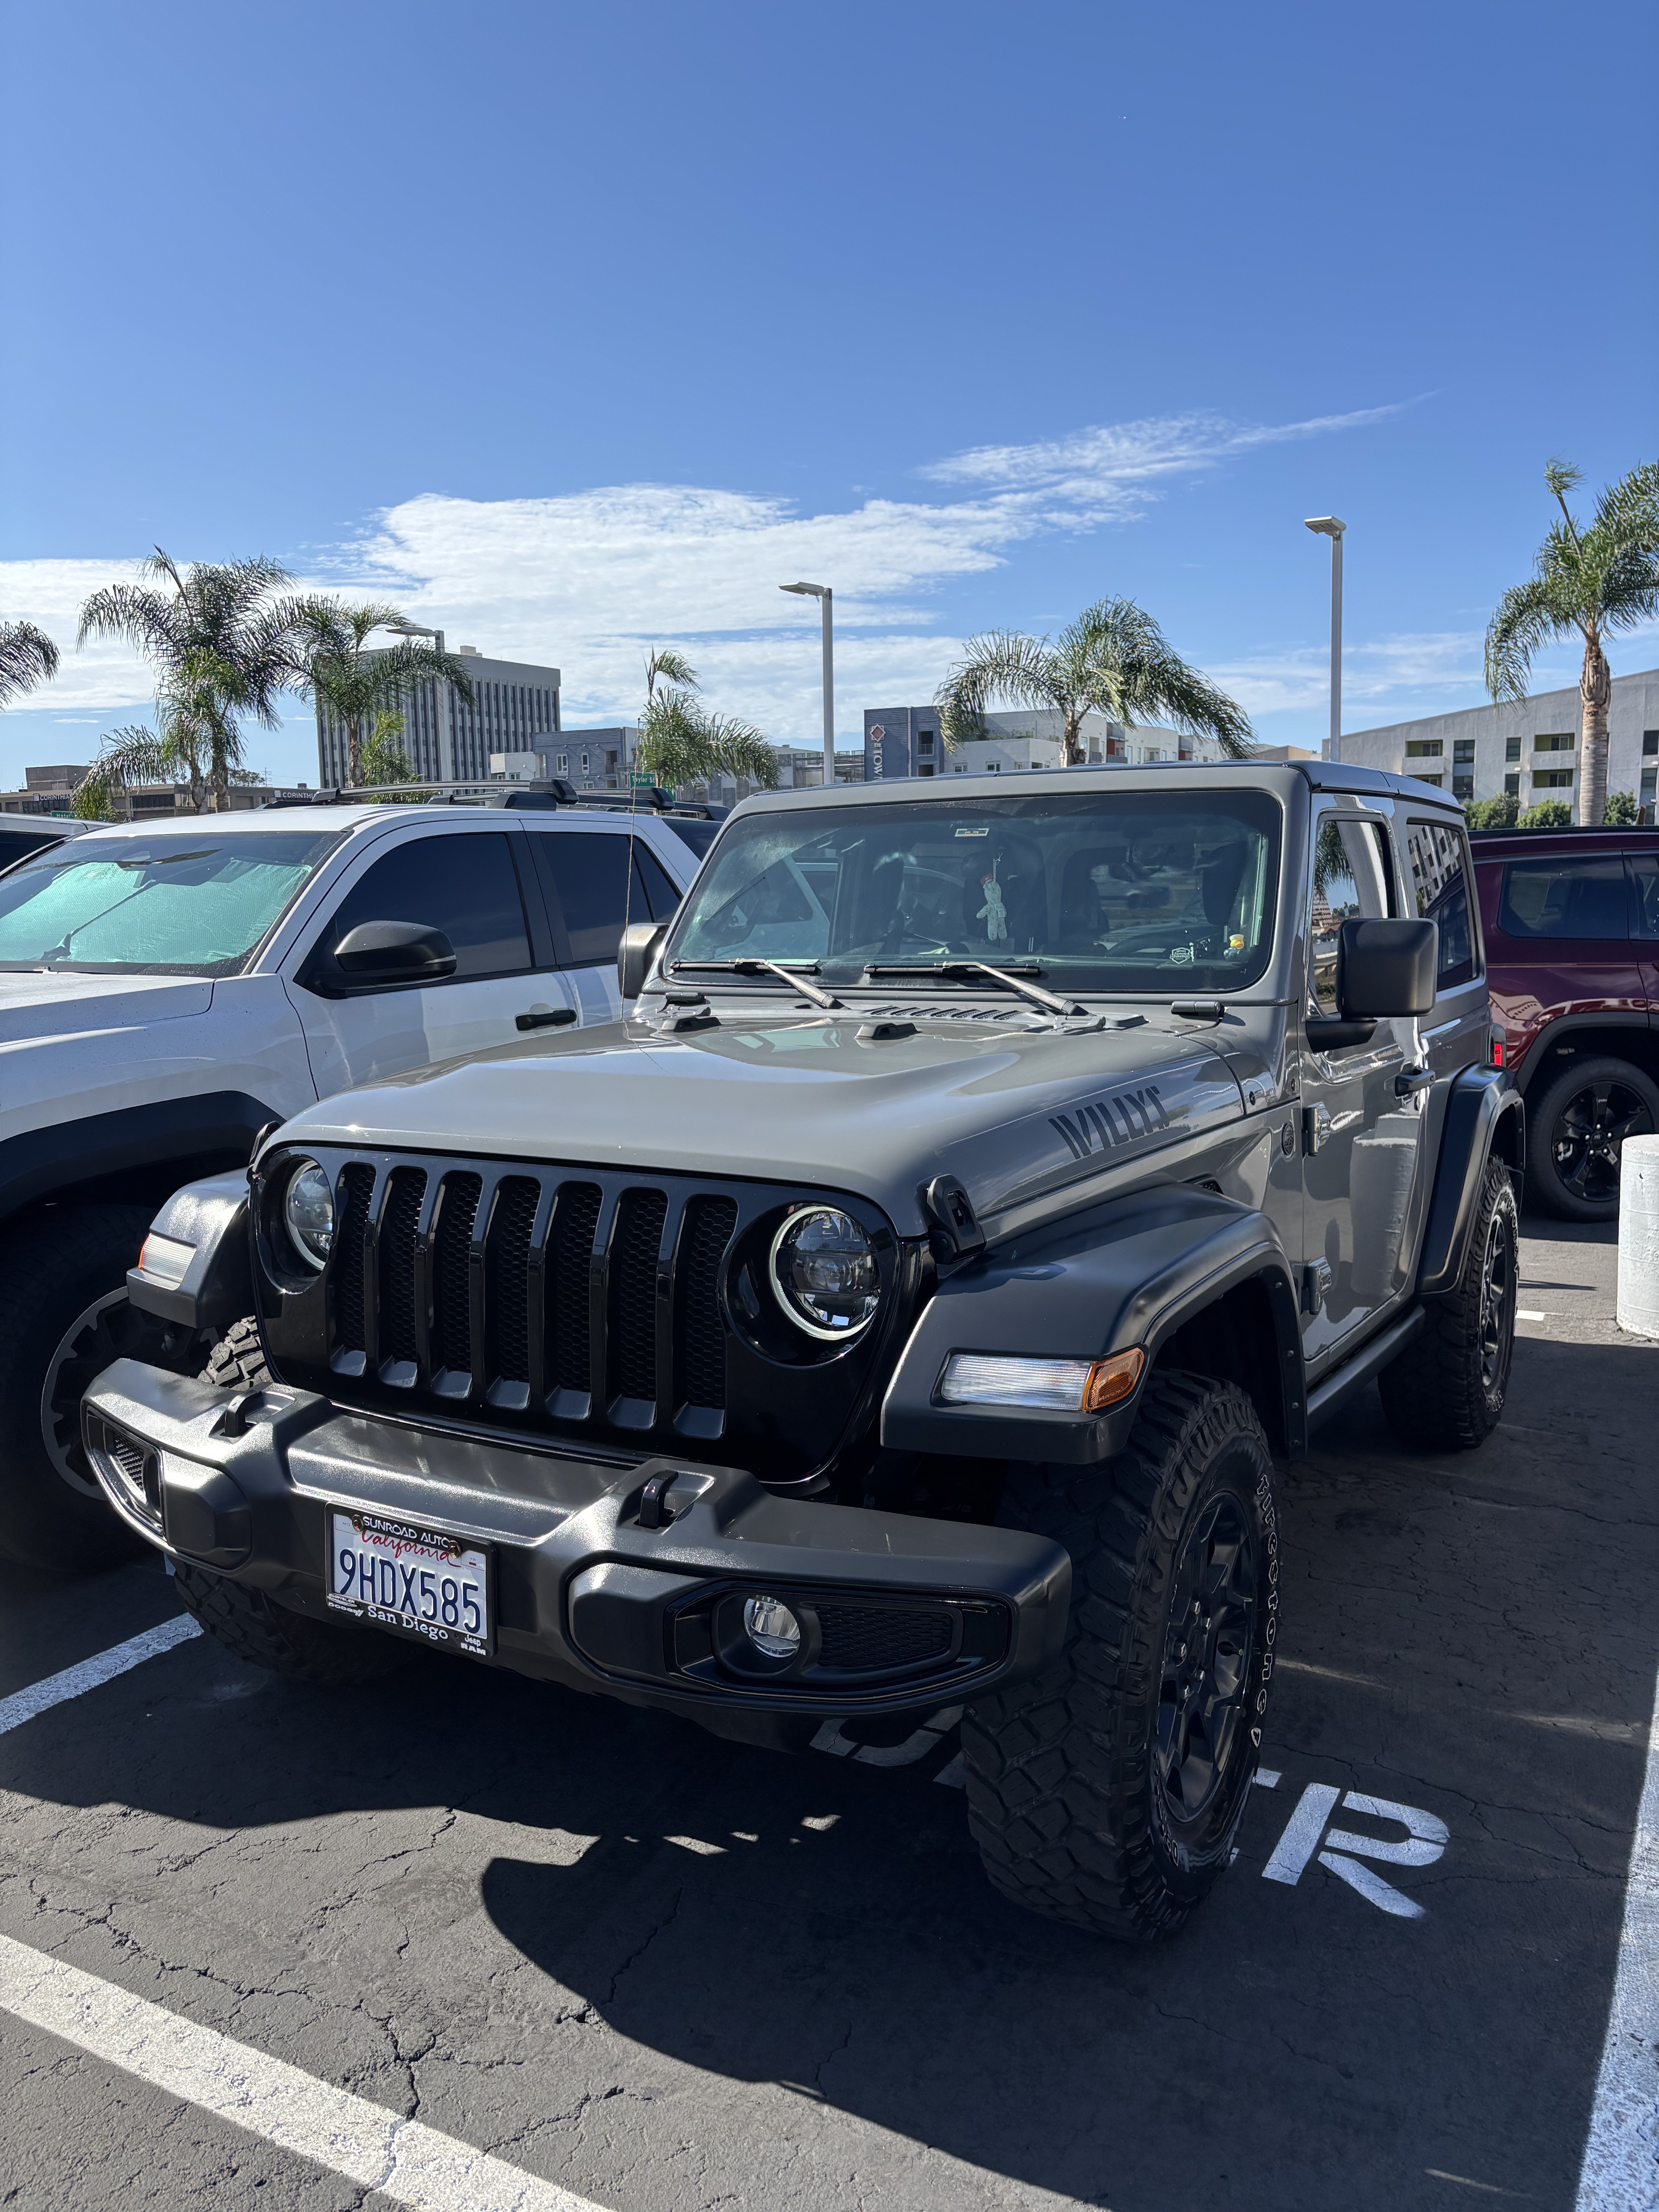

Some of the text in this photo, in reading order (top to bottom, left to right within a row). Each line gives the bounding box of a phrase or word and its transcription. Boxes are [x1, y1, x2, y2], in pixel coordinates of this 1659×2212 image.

[1048, 1086, 1170, 1160] WILLYS
[362, 1516, 450, 1548] SUNROAD AUTO
[361, 1530, 462, 1568] California
[328, 1593, 355, 1604] CHRYSLER
[328, 1601, 360, 1614] DODGE
[340, 1549, 481, 1634] 9HDX585
[1257, 1474, 1278, 1715] Firestone
[368, 1605, 449, 1640] San Diego
[460, 1642, 486, 1656] RAM
[464, 1634, 481, 1647] Jeep
